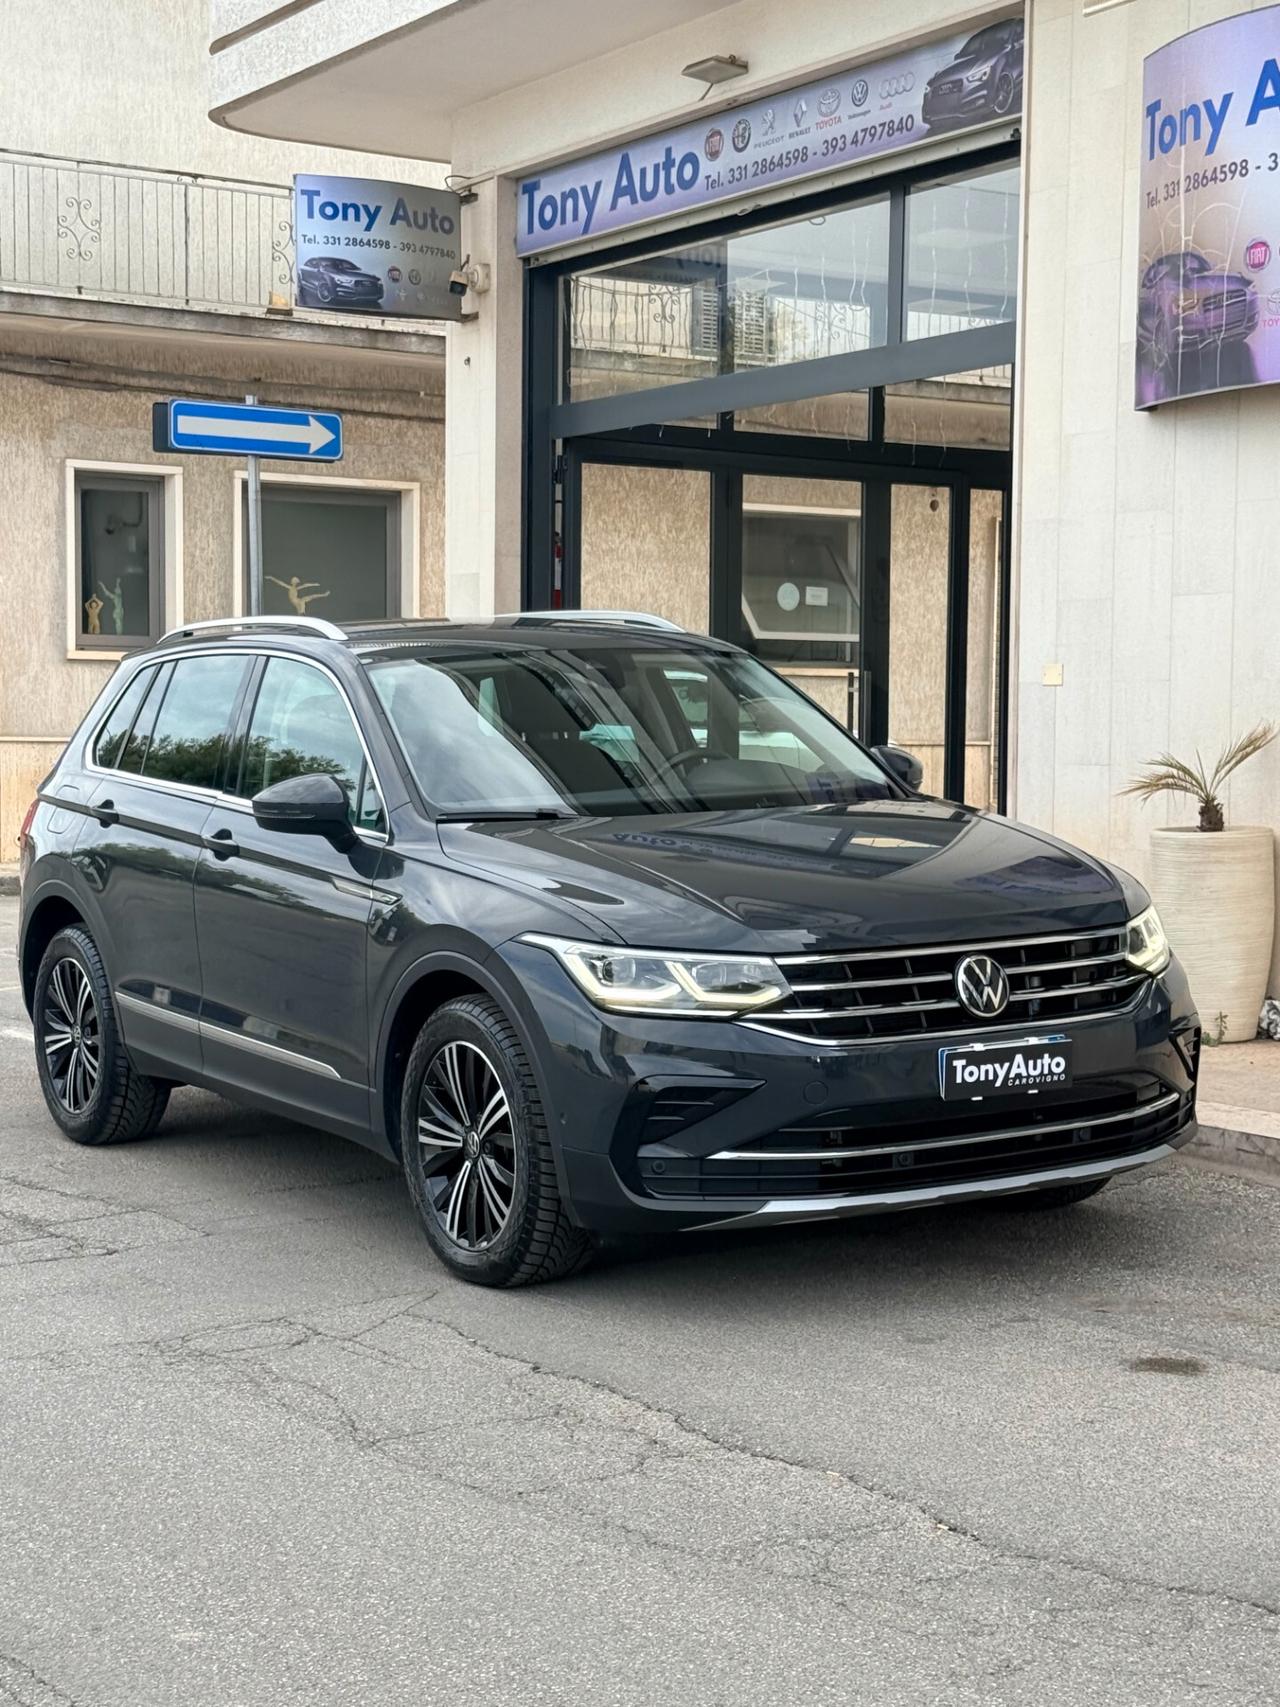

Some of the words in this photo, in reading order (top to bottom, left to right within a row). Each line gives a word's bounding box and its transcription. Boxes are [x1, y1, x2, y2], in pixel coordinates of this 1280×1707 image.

[815, 116, 842, 130] TOYOTA
[1146, 92, 1234, 161] Tony
[705, 172, 724, 192] Tel.
[728, 165, 748, 185] 331
[752, 146, 808, 178] 2864598
[821, 134, 847, 158] 393
[850, 114, 915, 148] 4797840
[522, 178, 603, 235] Tony
[609, 146, 700, 212] Auto
[1146, 190, 1161, 209] Tel.
[1163, 180, 1181, 201] 331
[1184, 159, 1249, 193] 2864598
[300, 189, 383, 232] Tony
[389, 197, 455, 235] Auto
[302, 234, 319, 245] Tel.
[323, 235, 341, 246] 331
[344, 237, 391, 250] 2864598
[400, 242, 417, 253] 393
[418, 245, 456, 260] 4797840
[1250, 246, 1267, 265] FIAT
[1007, 1073, 1066, 1086] CAROVIGNO
